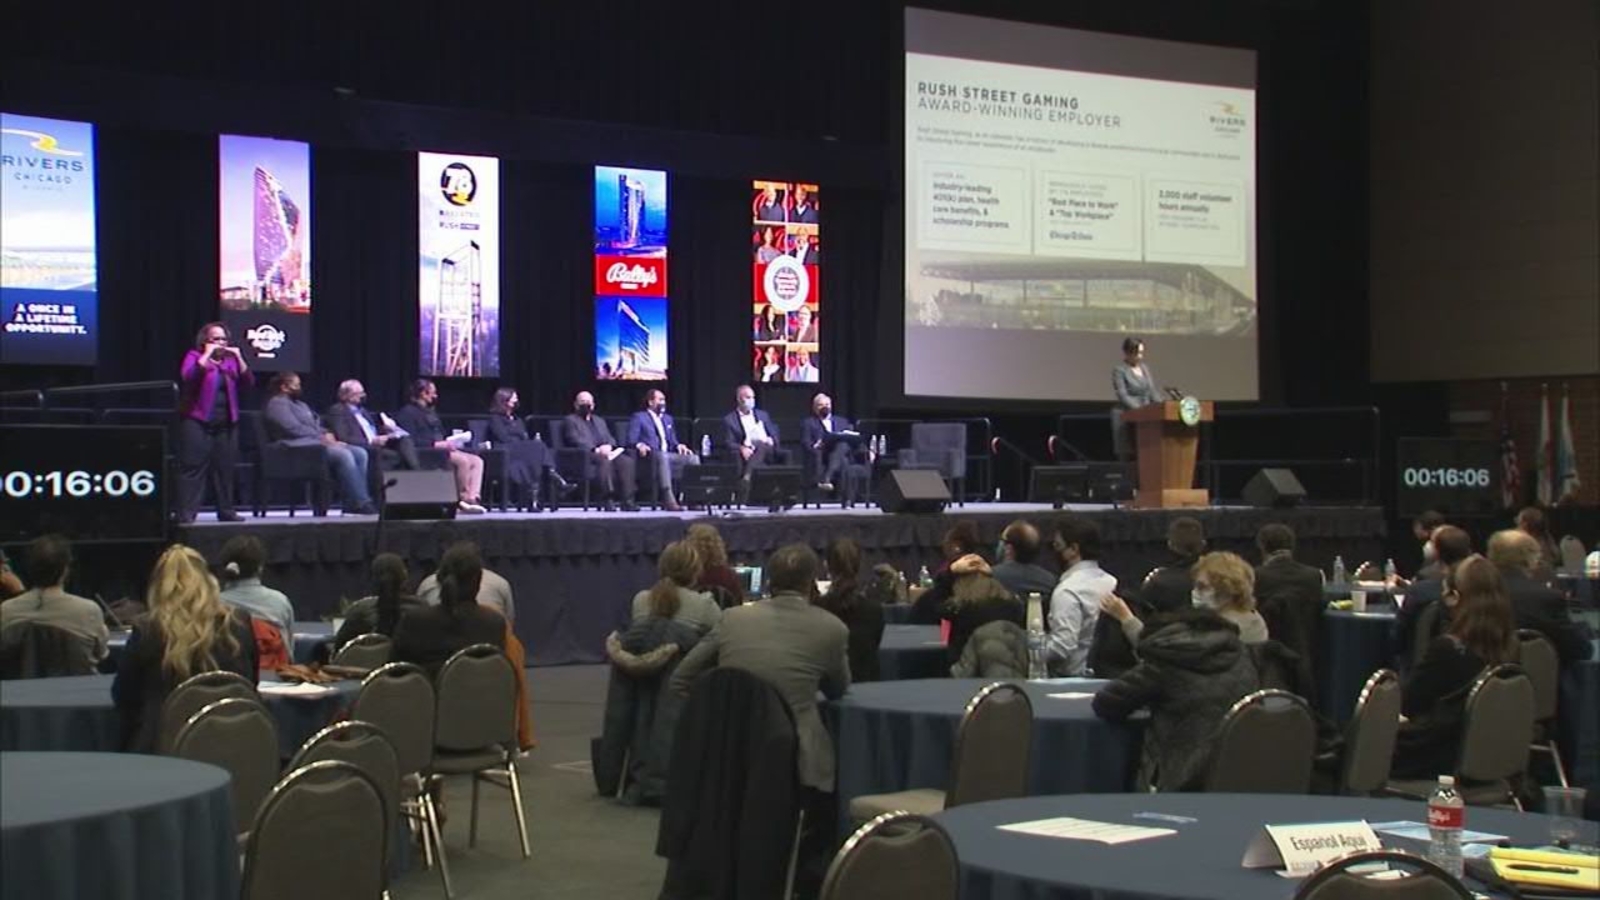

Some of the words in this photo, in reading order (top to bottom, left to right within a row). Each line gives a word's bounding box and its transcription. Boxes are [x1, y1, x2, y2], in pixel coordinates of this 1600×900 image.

[918, 82, 957, 98] RUSH
[963, 86, 1017, 103] STREET
[1022, 93, 1080, 110] GAMING
[917, 98, 1043, 121] AWARD-WINNING
[1048, 111, 1122, 128] EMPLOYER
[2, 155, 84, 172] RIVERS
[14, 172, 72, 184] CHICAGO
[606, 262, 657, 288] Bally's
[16, 303, 26, 312] A
[15, 313, 25, 322] A
[26, 314, 78, 324] LIFETIME
[5, 323, 87, 335] OPPORTUNITY.
[0, 470, 155, 497] 0:16:06
[1404, 467, 1490, 486] 00:16:06
